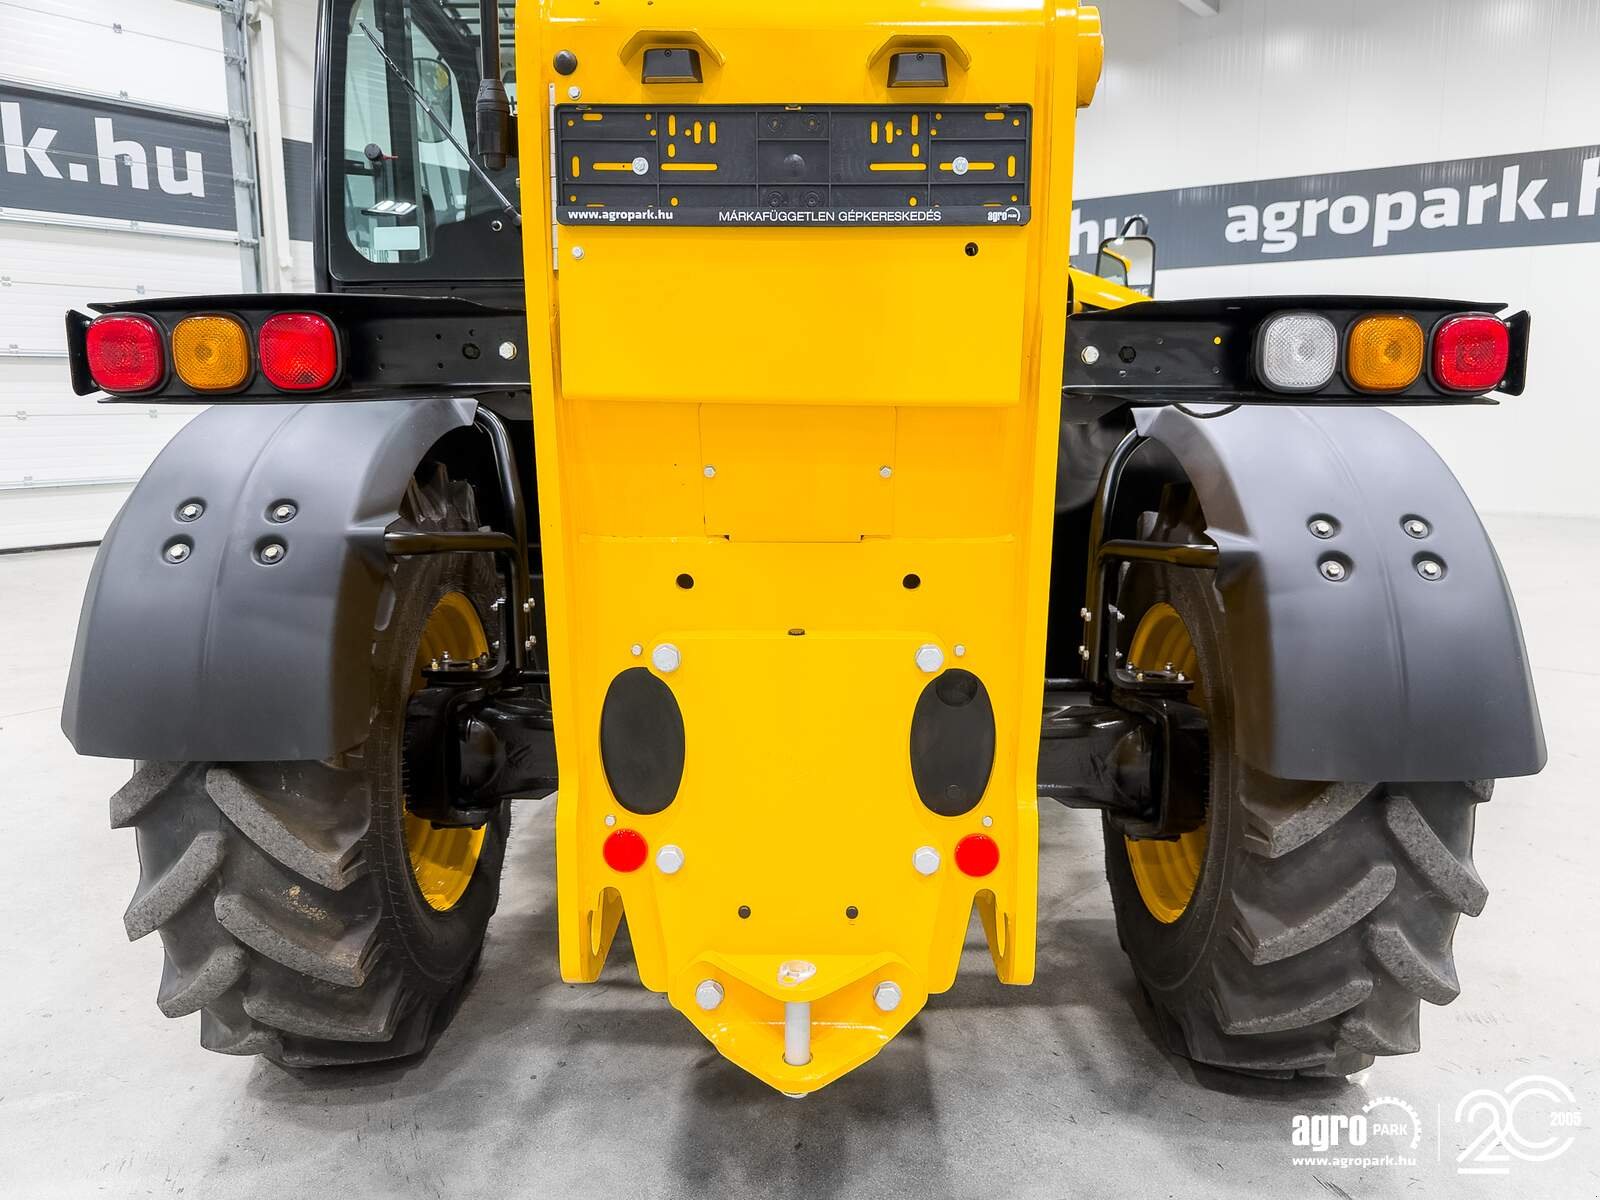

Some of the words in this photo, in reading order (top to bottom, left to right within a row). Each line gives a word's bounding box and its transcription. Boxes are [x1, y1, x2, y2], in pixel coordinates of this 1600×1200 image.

[567, 209, 673, 222] www.agropark.hu
[718, 209, 836, 222] MÁRKAFÜGGETLEN
[838, 209, 942, 222] GÉPKERESKEDÉS
[987, 211, 1008, 223] agro
